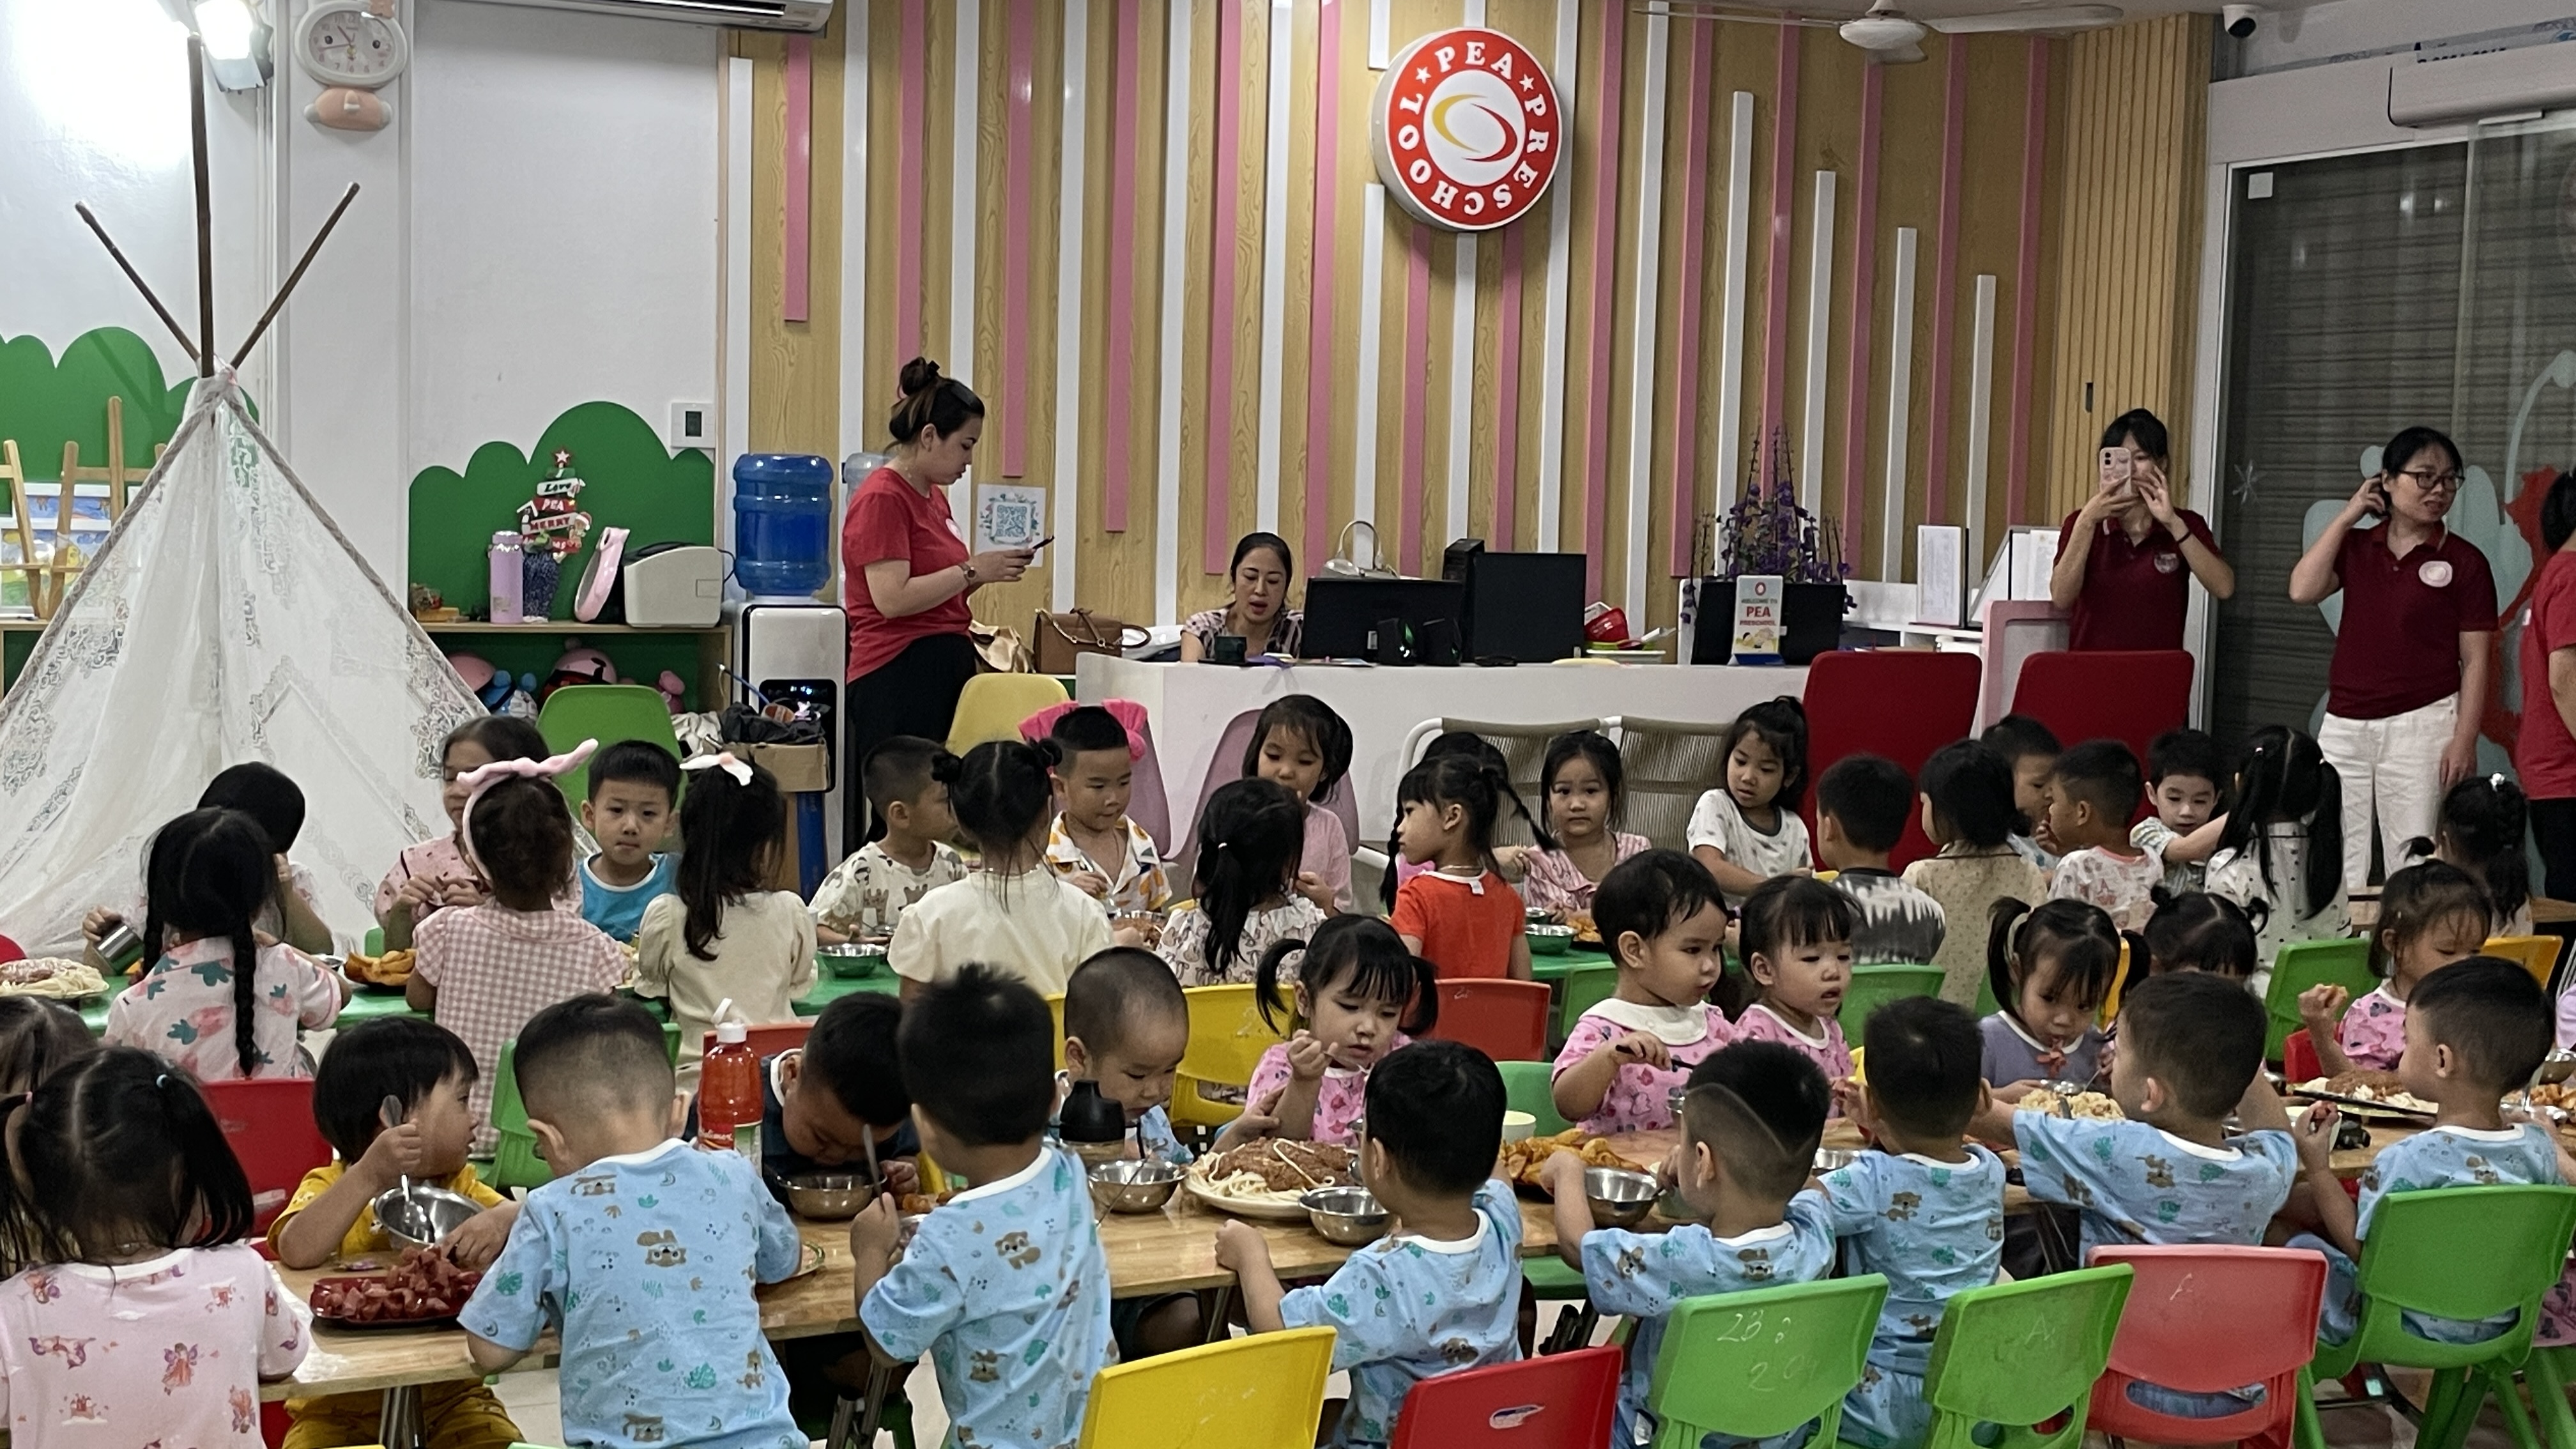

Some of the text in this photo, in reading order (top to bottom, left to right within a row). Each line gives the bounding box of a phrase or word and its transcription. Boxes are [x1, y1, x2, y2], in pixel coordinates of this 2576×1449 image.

[1434, 42, 1514, 80] PEA
[1398, 93, 1549, 216] PRESCHOOL
[542, 498, 565, 511] PEA
[530, 516, 571, 531] MERRY
[1746, 606, 1771, 617] PEA
